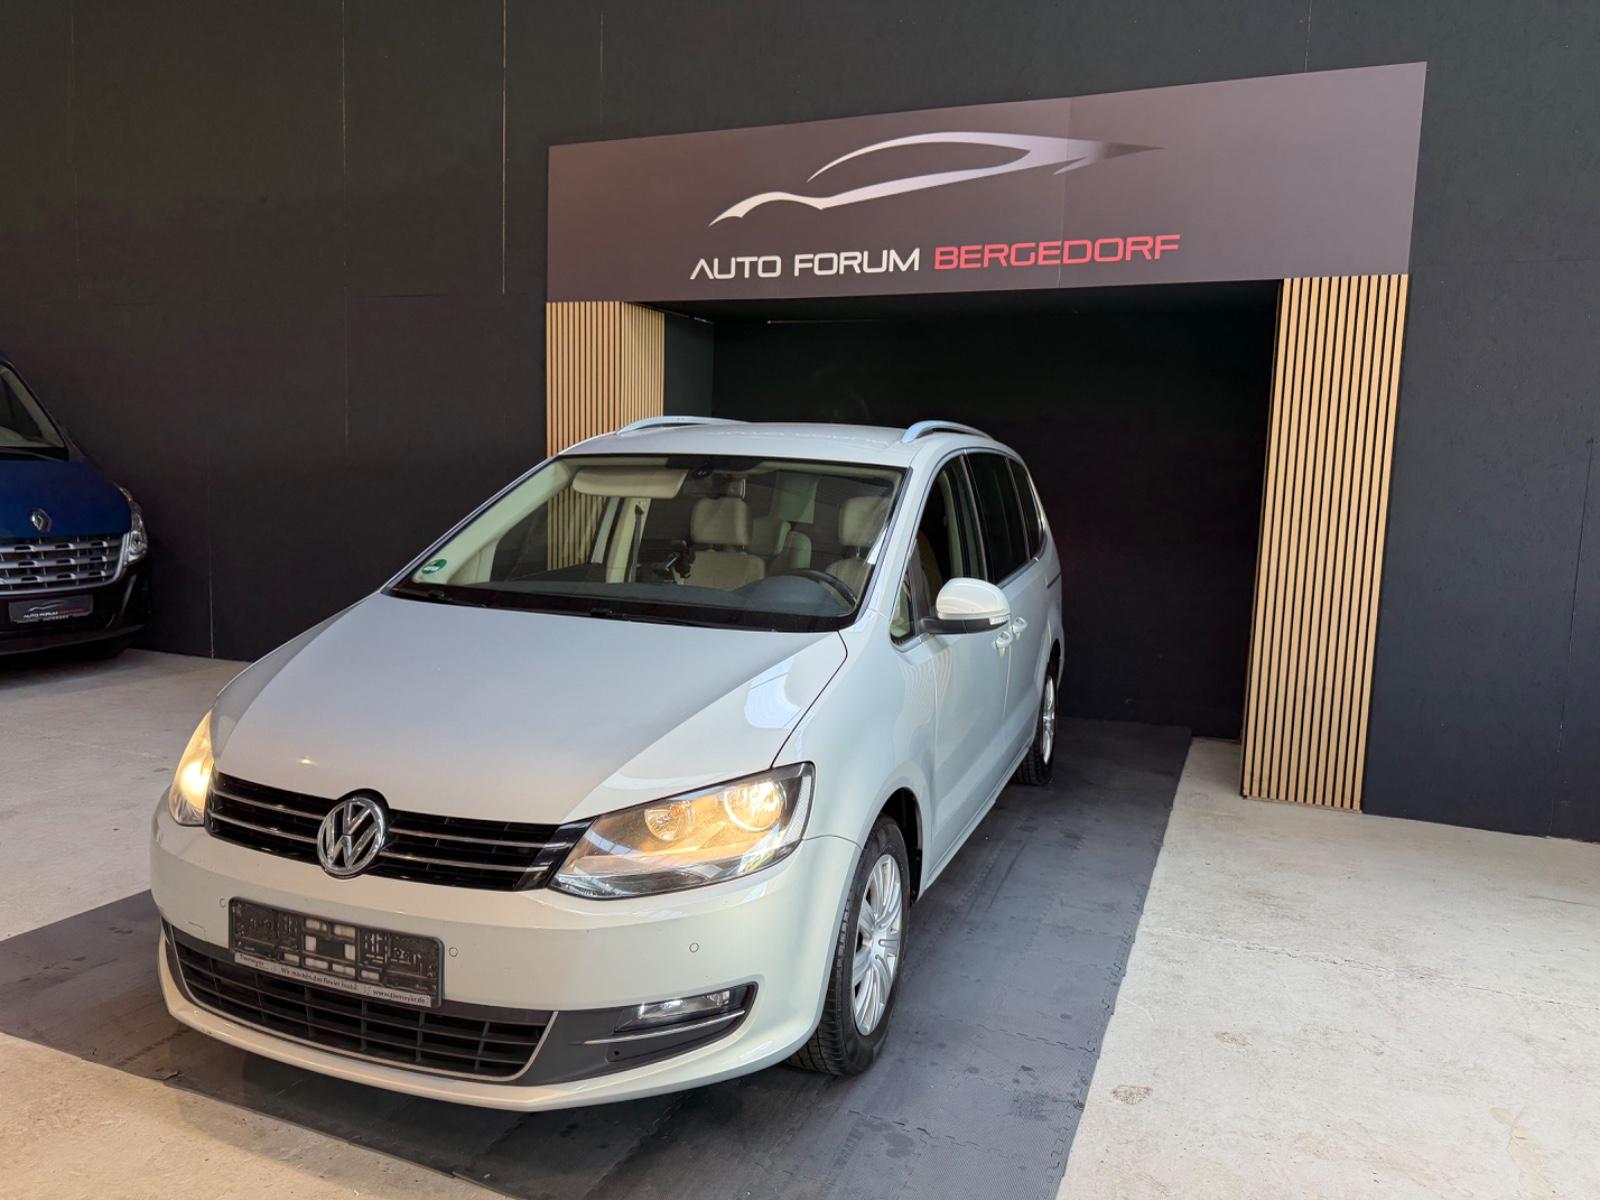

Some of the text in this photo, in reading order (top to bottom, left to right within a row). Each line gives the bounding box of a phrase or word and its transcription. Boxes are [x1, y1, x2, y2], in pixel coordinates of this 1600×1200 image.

[690, 234, 1181, 280] AUTO FORUM BERGEDORF
